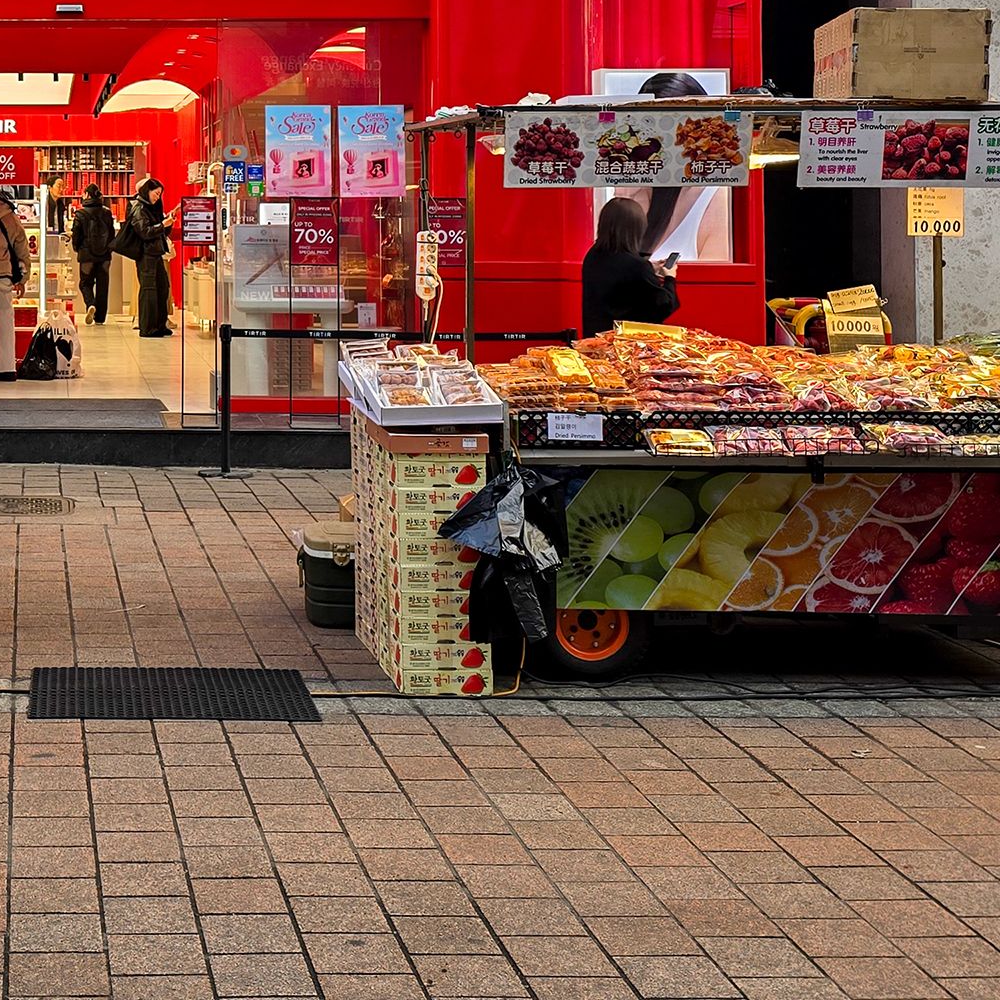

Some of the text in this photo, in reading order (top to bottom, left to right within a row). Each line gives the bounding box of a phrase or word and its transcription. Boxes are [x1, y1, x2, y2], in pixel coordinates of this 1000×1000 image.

[278, 116, 316, 135] Sale
[351, 116, 389, 135] Sale
[809, 117, 857, 135] 草莓干
[860, 123, 898, 132] Strawberry
[528, 161, 568, 175] 草莓干
[595, 160, 663, 175] 混合蔬菜干
[691, 160, 731, 174] 柿子干
[539, 177, 576, 185] Strawberry
[914, 220, 961, 233] 10.000
[294, 228, 334, 244] 70%
[431, 229, 464, 245] 0%
[241, 291, 270, 300] NEW
[832, 320, 871, 332] 10.000
[428, 464, 445, 478] 딸기
[428, 491, 446, 504] 딸기
[430, 542, 447, 555] 딸기
[431, 570, 448, 583] 딸기
[432, 595, 448, 608] 딸기
[432, 620, 448, 634] 딸기
[434, 647, 450, 661] 딸기
[434, 673, 450, 687] 딸기
